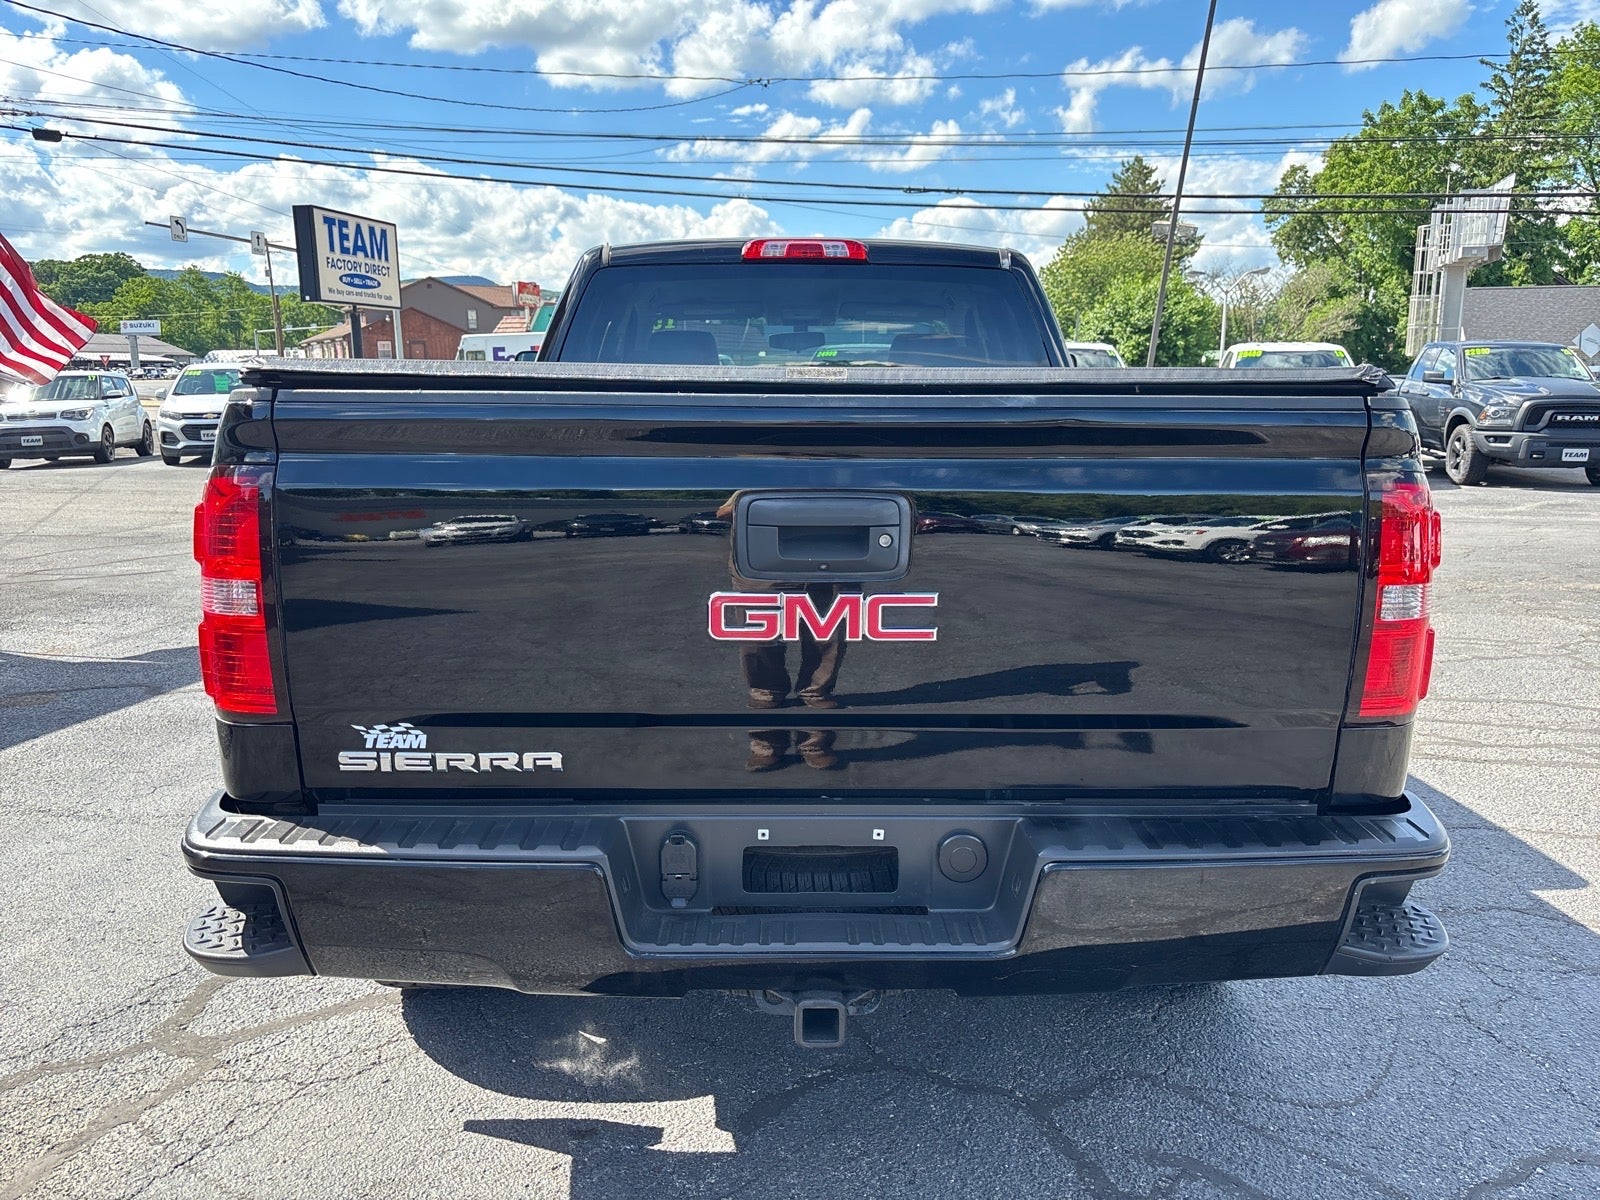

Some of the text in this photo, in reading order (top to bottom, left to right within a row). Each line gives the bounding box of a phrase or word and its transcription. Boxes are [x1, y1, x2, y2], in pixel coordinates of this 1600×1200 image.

[323, 216, 389, 262] TEAM
[326, 257, 391, 277] FACTORY DIRECT
[336, 288, 345, 296] buy
[363, 291, 377, 299] trucks
[708, 591, 939, 642] GMC
[363, 733, 427, 749] TEAM
[337, 751, 564, 773] SIERRA
